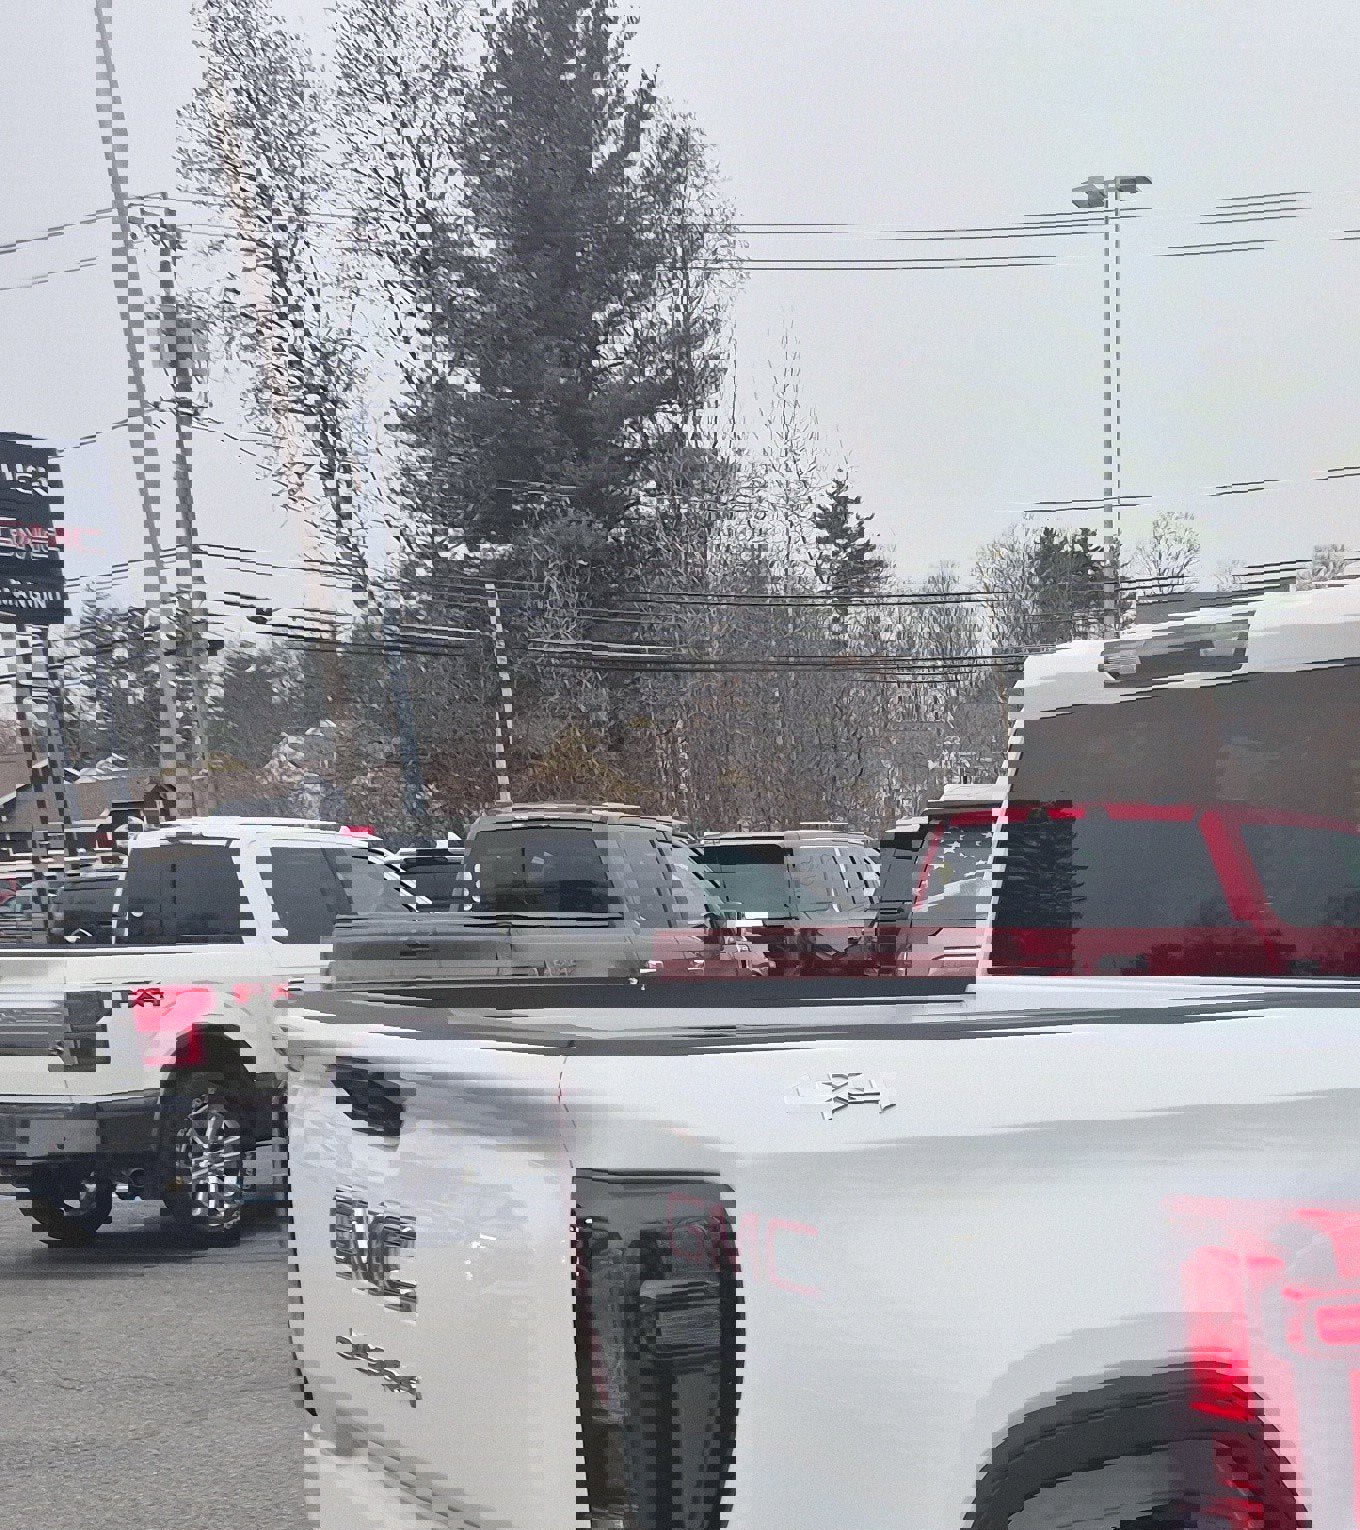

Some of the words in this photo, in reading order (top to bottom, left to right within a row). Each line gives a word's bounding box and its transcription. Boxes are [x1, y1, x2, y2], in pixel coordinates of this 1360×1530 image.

[0, 457, 101, 491] UICK
[0, 516, 109, 557] GMC
[9, 578, 110, 605] MANGINO
[231, 980, 324, 1005] FX4
[665, 1179, 835, 1312] GMC
[684, 1325, 838, 1402] SIERRA
